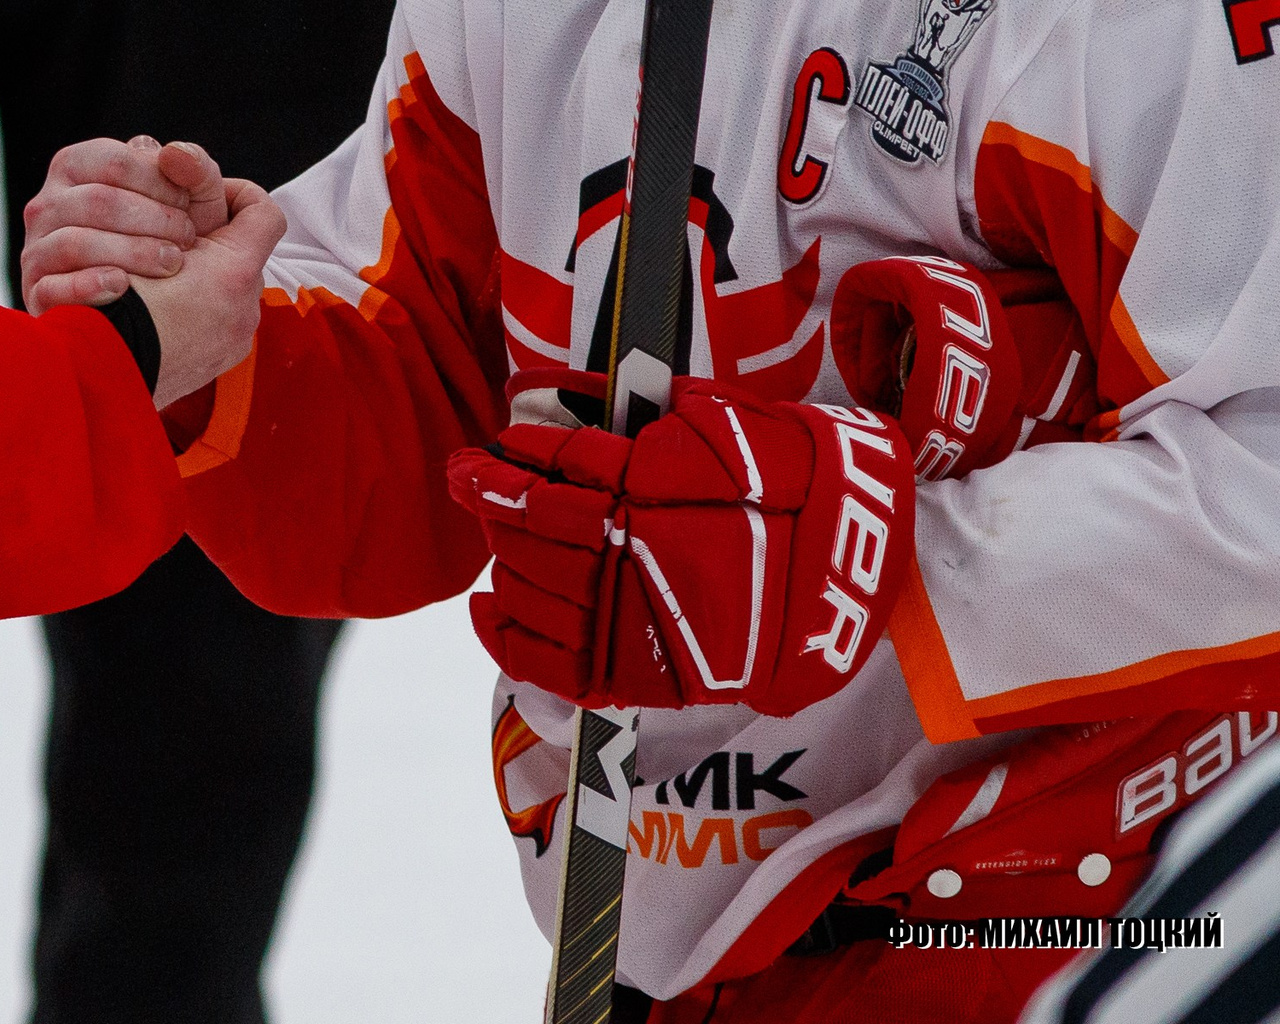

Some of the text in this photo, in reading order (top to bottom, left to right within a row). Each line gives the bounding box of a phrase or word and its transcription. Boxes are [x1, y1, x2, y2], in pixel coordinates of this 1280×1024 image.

[857, 65, 948, 158] ПЛЕЙ-ОФФ
[873, 120, 920, 158] OLIMPBET
[799, 403, 896, 673] AUER
[634, 748, 810, 811] МК
[1116, 710, 1280, 835] BAU
[626, 808, 815, 869] MMC
